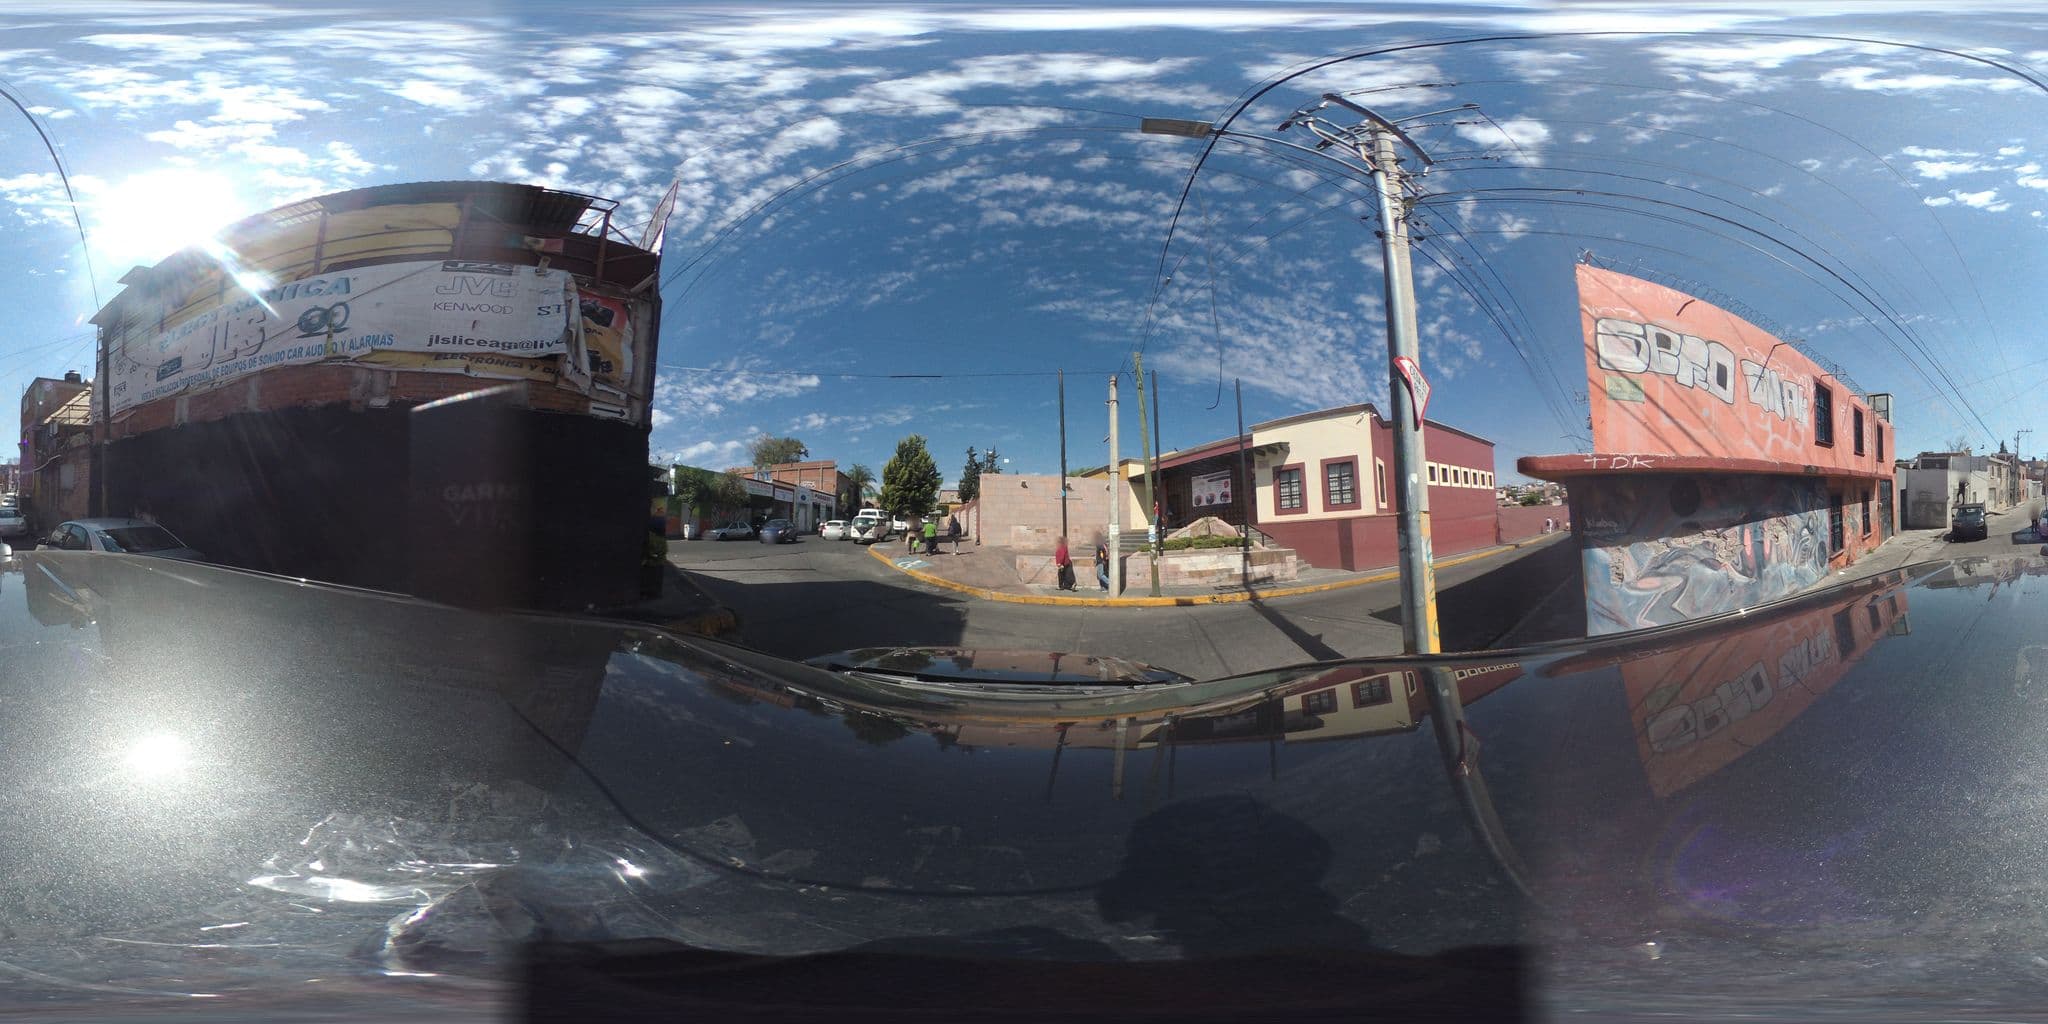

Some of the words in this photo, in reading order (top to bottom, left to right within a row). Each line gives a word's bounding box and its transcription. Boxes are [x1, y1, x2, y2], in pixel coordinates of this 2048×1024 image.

[433, 302, 514, 315] KENWOOD
[220, 361, 247, 377] EQUIPOS
[248, 357, 257, 368] DE
[258, 351, 286, 366] SONIDO
[287, 347, 303, 359] CAR
[340, 340, 347, 351] Y
[349, 334, 394, 350] ALARMAS
